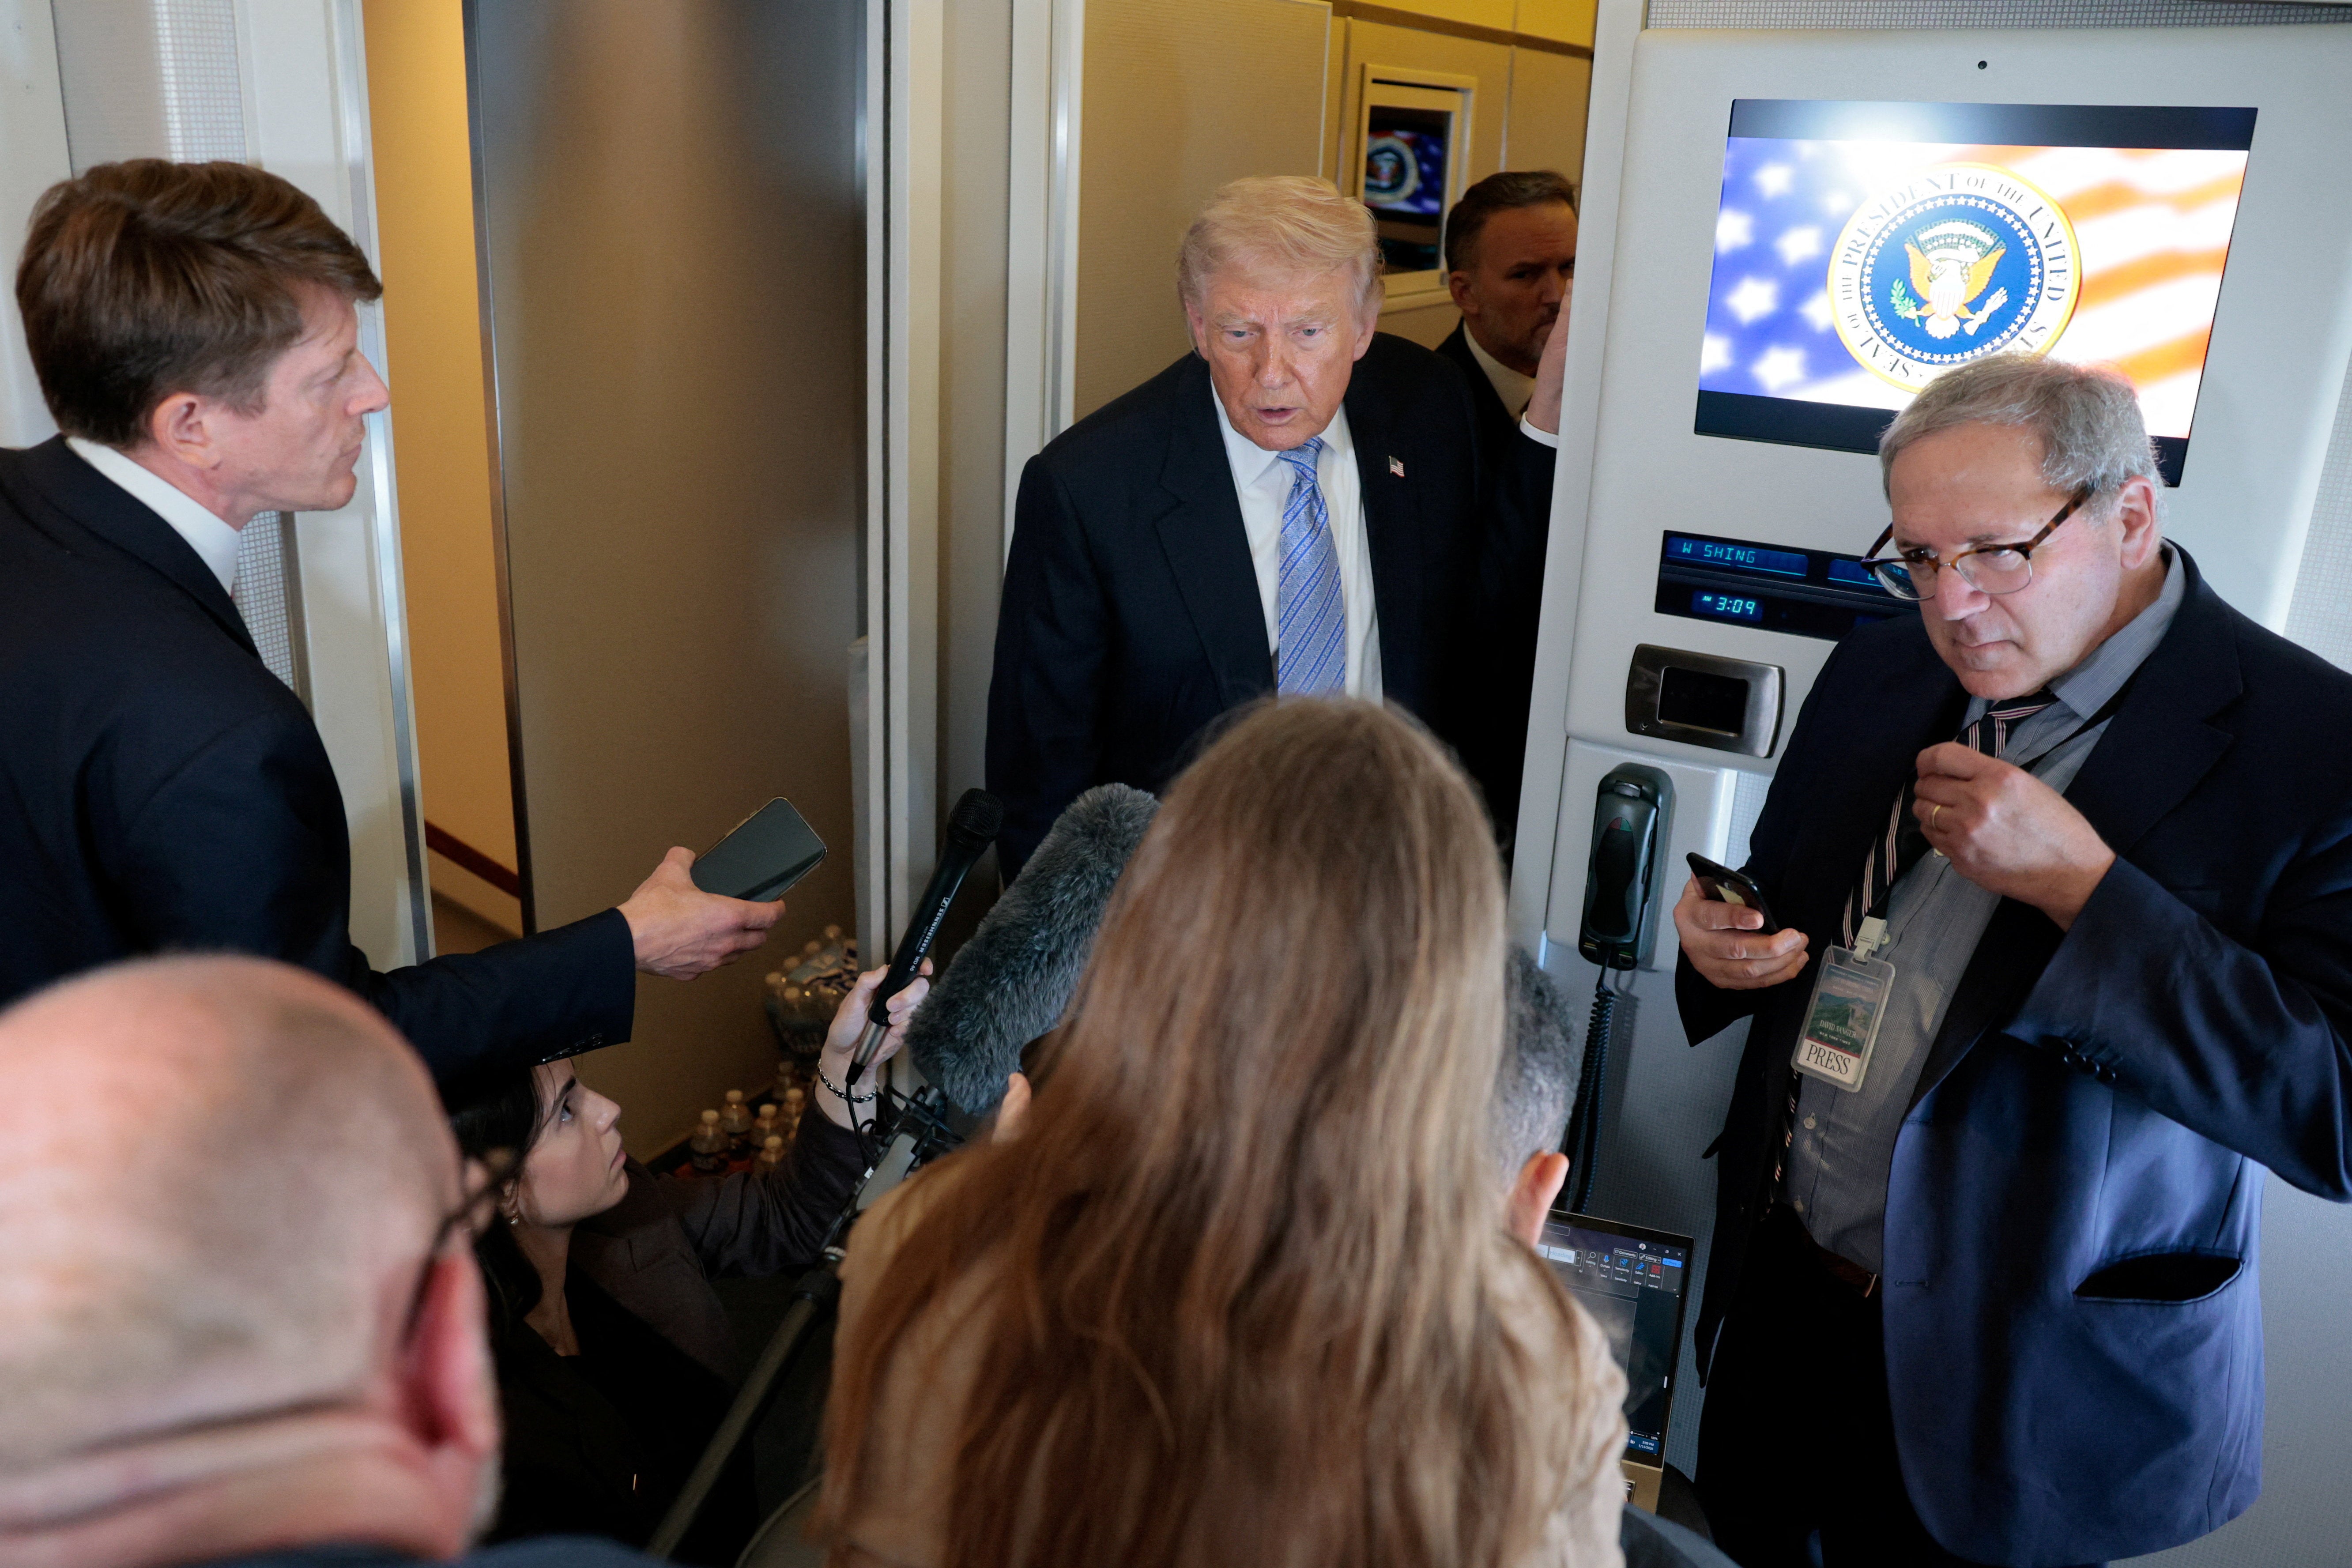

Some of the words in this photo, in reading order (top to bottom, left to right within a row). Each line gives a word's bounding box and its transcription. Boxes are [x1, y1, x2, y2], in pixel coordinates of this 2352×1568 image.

[1843, 173, 1960, 265] PRESIDENT
[1967, 177, 1989, 188] OF
[1996, 182, 2026, 206] THE
[2030, 206, 2067, 301] UNITED
[1716, 597, 1755, 614] 3:09
[919, 908, 944, 953] SENNHEISER
[913, 956, 920, 965] MD
[1819, 1020, 1836, 1030] DAVID
[1836, 1025, 1857, 1038] SANGER
[1805, 1044, 1851, 1075] PRESS
[1550, 1251, 1572, 1260] Heading
